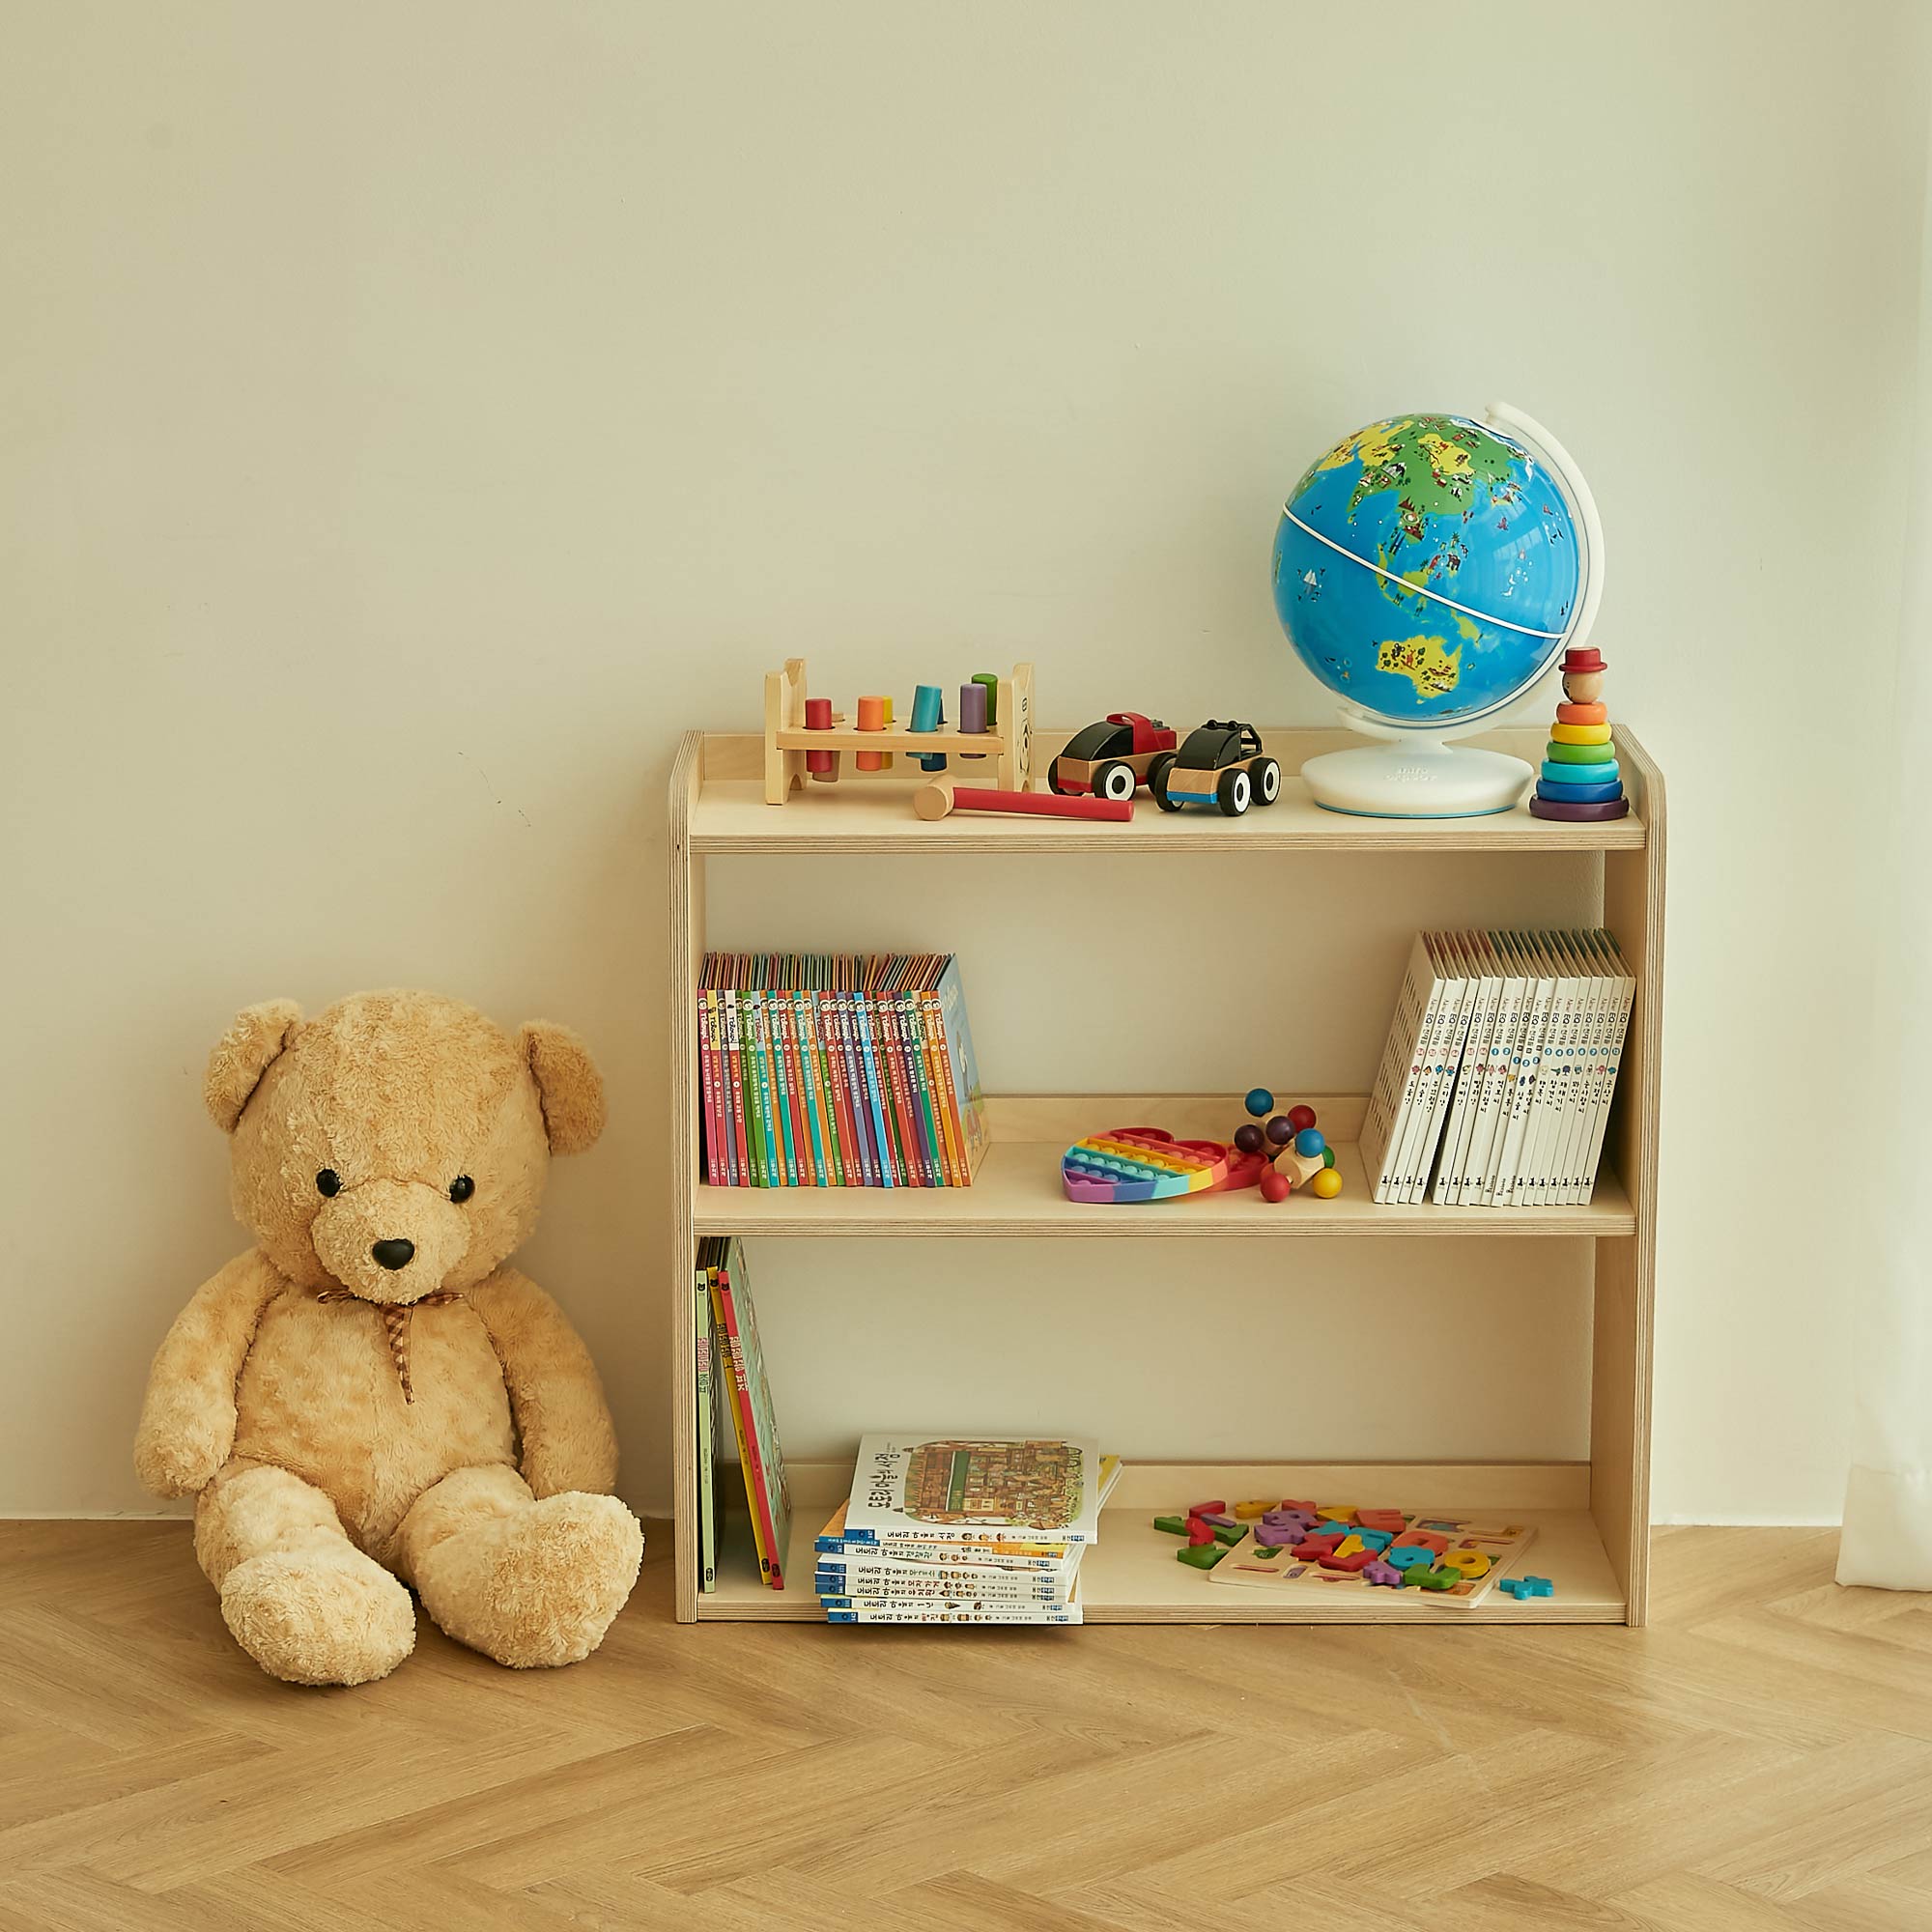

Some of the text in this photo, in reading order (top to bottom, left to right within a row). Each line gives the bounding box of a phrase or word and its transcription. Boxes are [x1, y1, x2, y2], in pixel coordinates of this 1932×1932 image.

[868, 1453, 900, 1508] 도토리 마을의 서점
